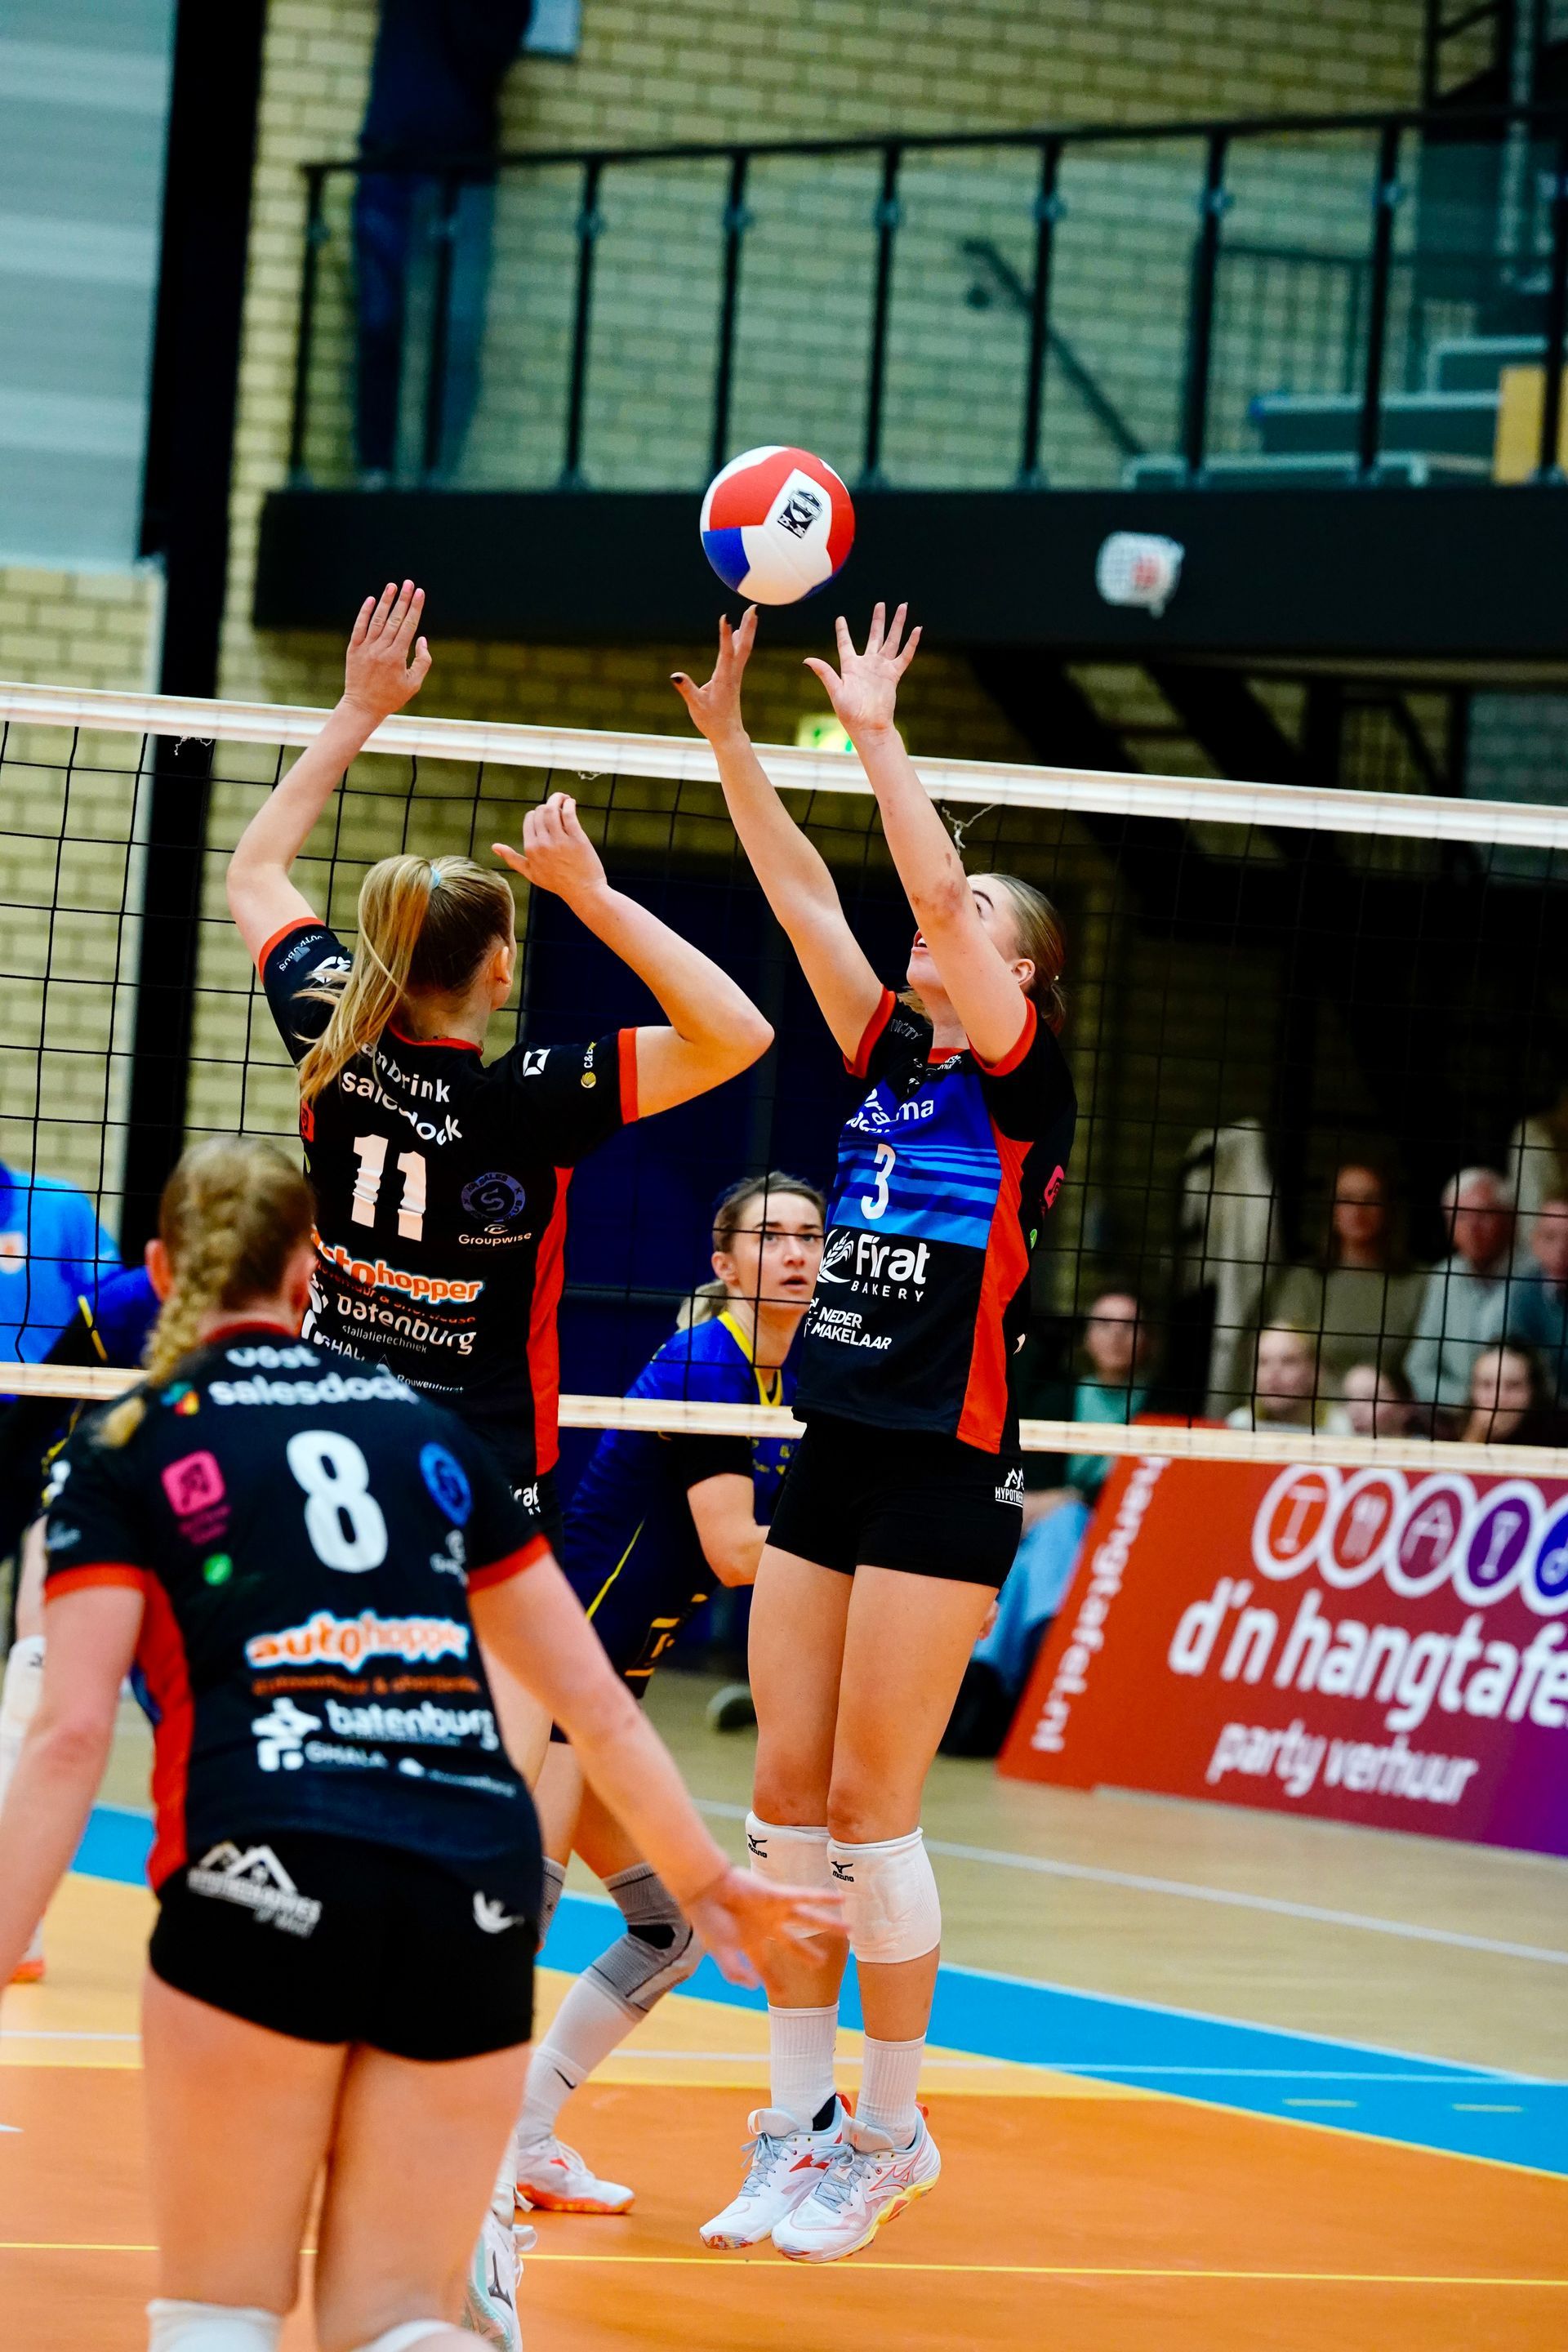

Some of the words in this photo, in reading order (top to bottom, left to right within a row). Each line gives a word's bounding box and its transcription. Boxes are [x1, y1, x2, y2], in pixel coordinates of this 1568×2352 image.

[351, 1134, 426, 1241] 11
[861, 1143, 896, 1219] 3
[311, 1225, 484, 1305] tohopper
[458, 1233, 532, 1247] Groupwise
[856, 1233, 931, 1285] Firat
[850, 1281, 924, 1303] BAKERY
[342, 1325, 428, 1354] stallatietechniek
[810, 1322, 892, 1350] MAKELAAR
[818, 1307, 862, 1330] NEDER
[208, 1370, 420, 1405] salesdock
[286, 1429, 388, 1574] 8
[1169, 1577, 1279, 1686] d'n
[1274, 1588, 1568, 1733] hangtafe
[1206, 1719, 1326, 1797] party
[1325, 1733, 1479, 1805] verhuur
